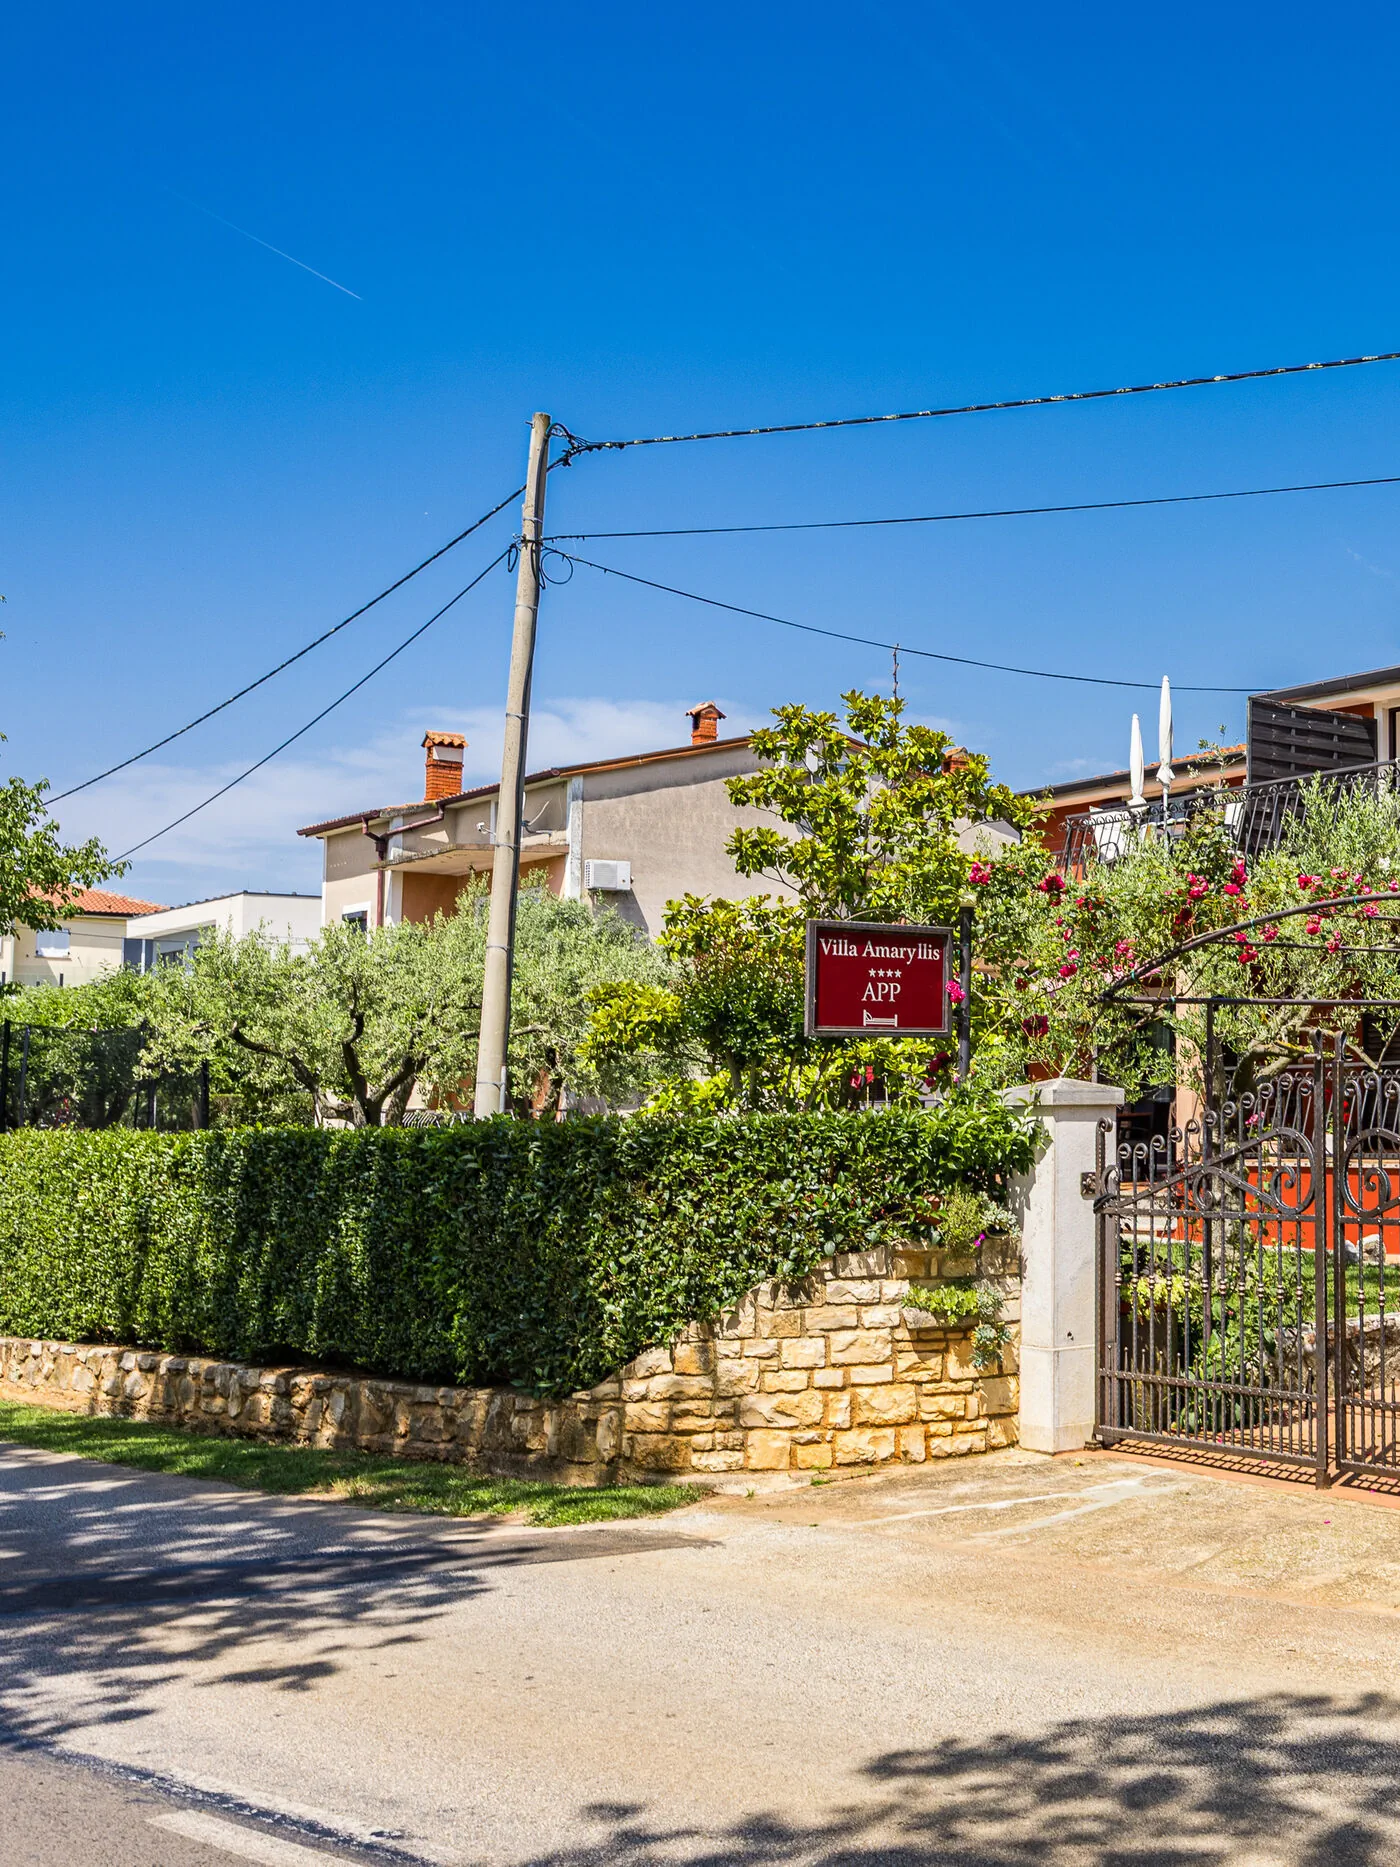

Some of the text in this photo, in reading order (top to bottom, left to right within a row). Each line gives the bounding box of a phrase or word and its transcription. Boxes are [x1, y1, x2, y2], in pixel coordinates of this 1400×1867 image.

[819, 938, 940, 965] Villa Amaryllis
[861, 982, 901, 1002] APP
